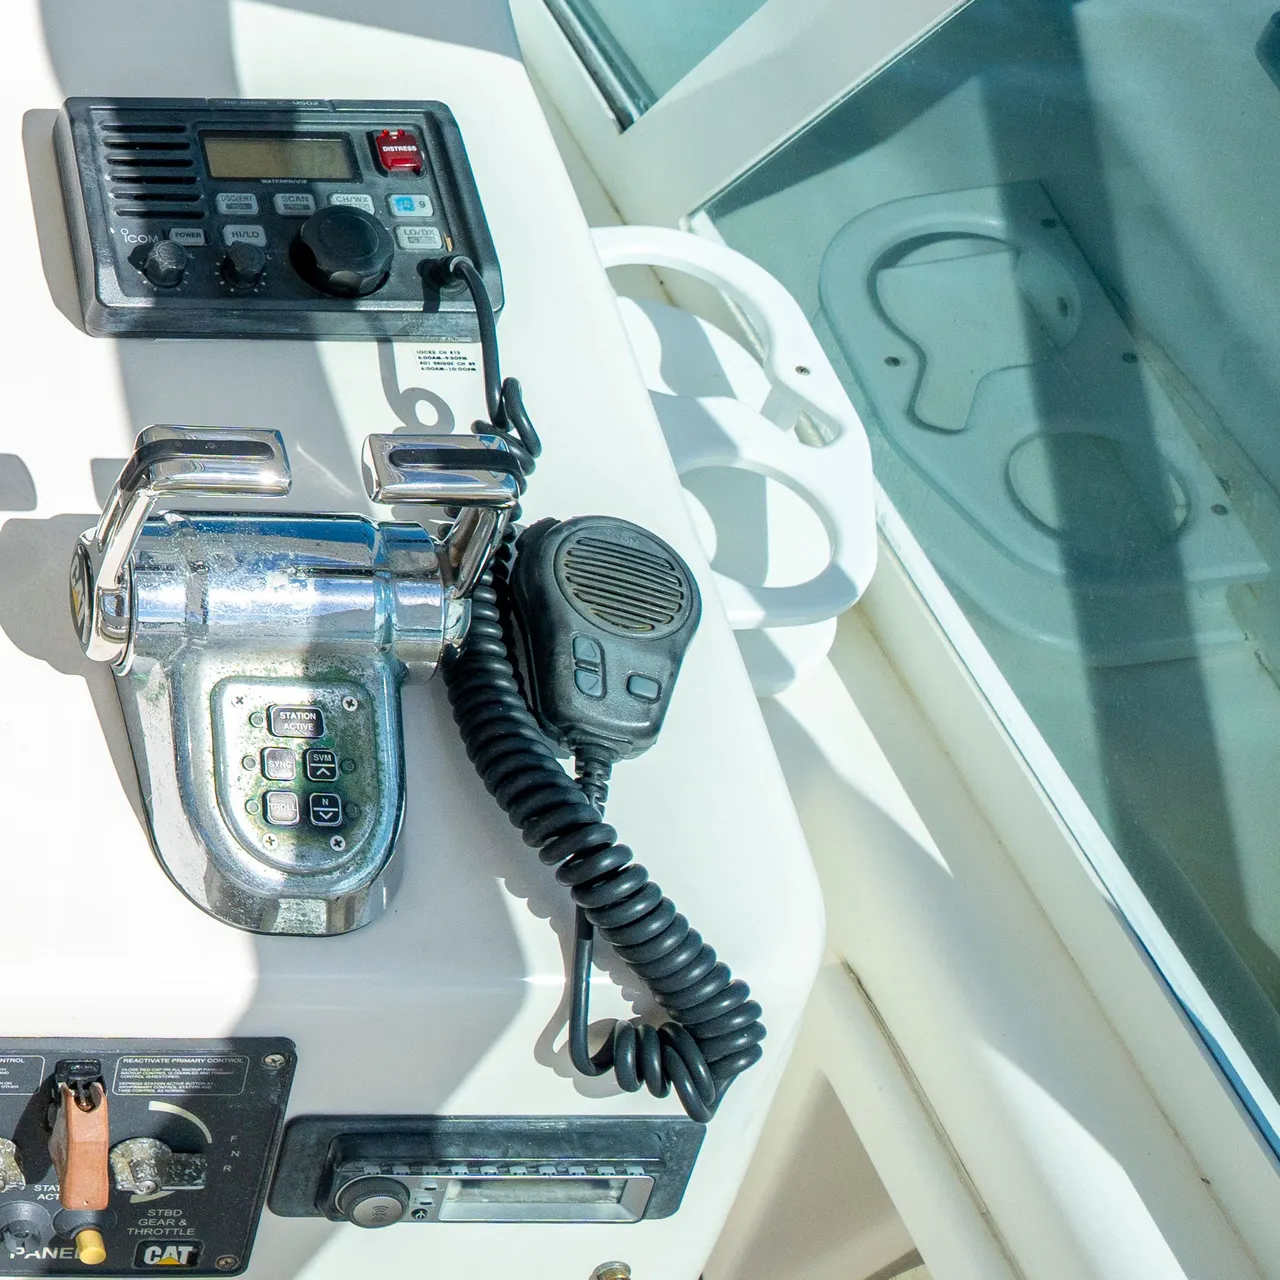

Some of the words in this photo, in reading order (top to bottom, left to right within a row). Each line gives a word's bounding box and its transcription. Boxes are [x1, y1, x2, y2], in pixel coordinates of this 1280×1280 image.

[418, 200, 426, 208] 9
[403, 228, 436, 236] LO/DX
[280, 712, 316, 720] STATION
[147, 1209, 183, 1217] STBD
[138, 1218, 176, 1226] GEAR
[127, 1228, 195, 1236] THROTTLE
[144, 1246, 193, 1265] CAT
